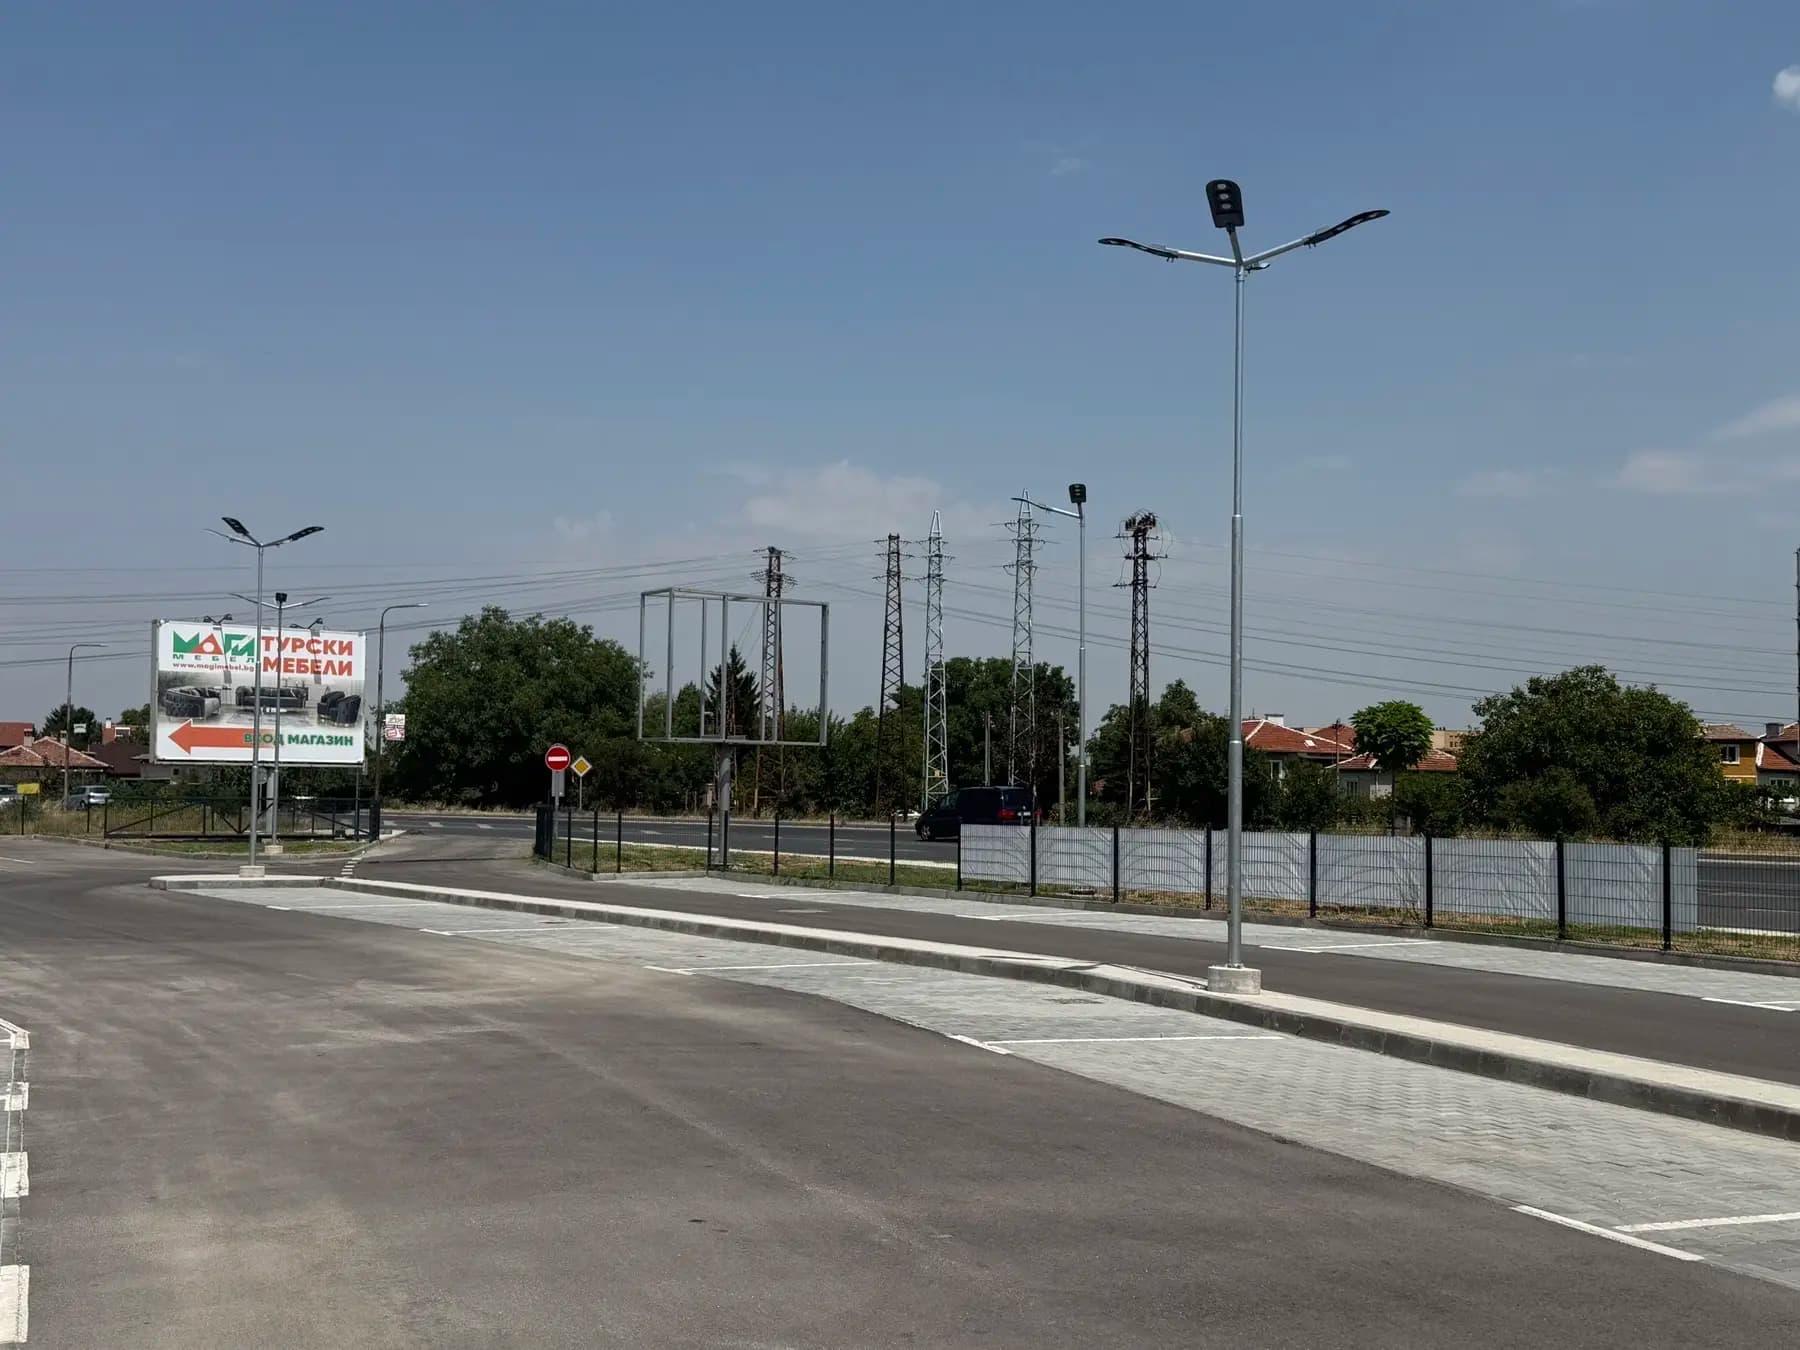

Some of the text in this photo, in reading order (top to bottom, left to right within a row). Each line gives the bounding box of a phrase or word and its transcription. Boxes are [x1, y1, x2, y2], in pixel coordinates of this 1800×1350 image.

[173, 630, 255, 656] МАГИ
[262, 636, 353, 656] ТУРСКИ
[173, 654, 255, 663] МЕБЕЛ
[262, 656, 353, 677] МЕБЕЛИ
[244, 733, 353, 746] ВОД МАГАЗИН
